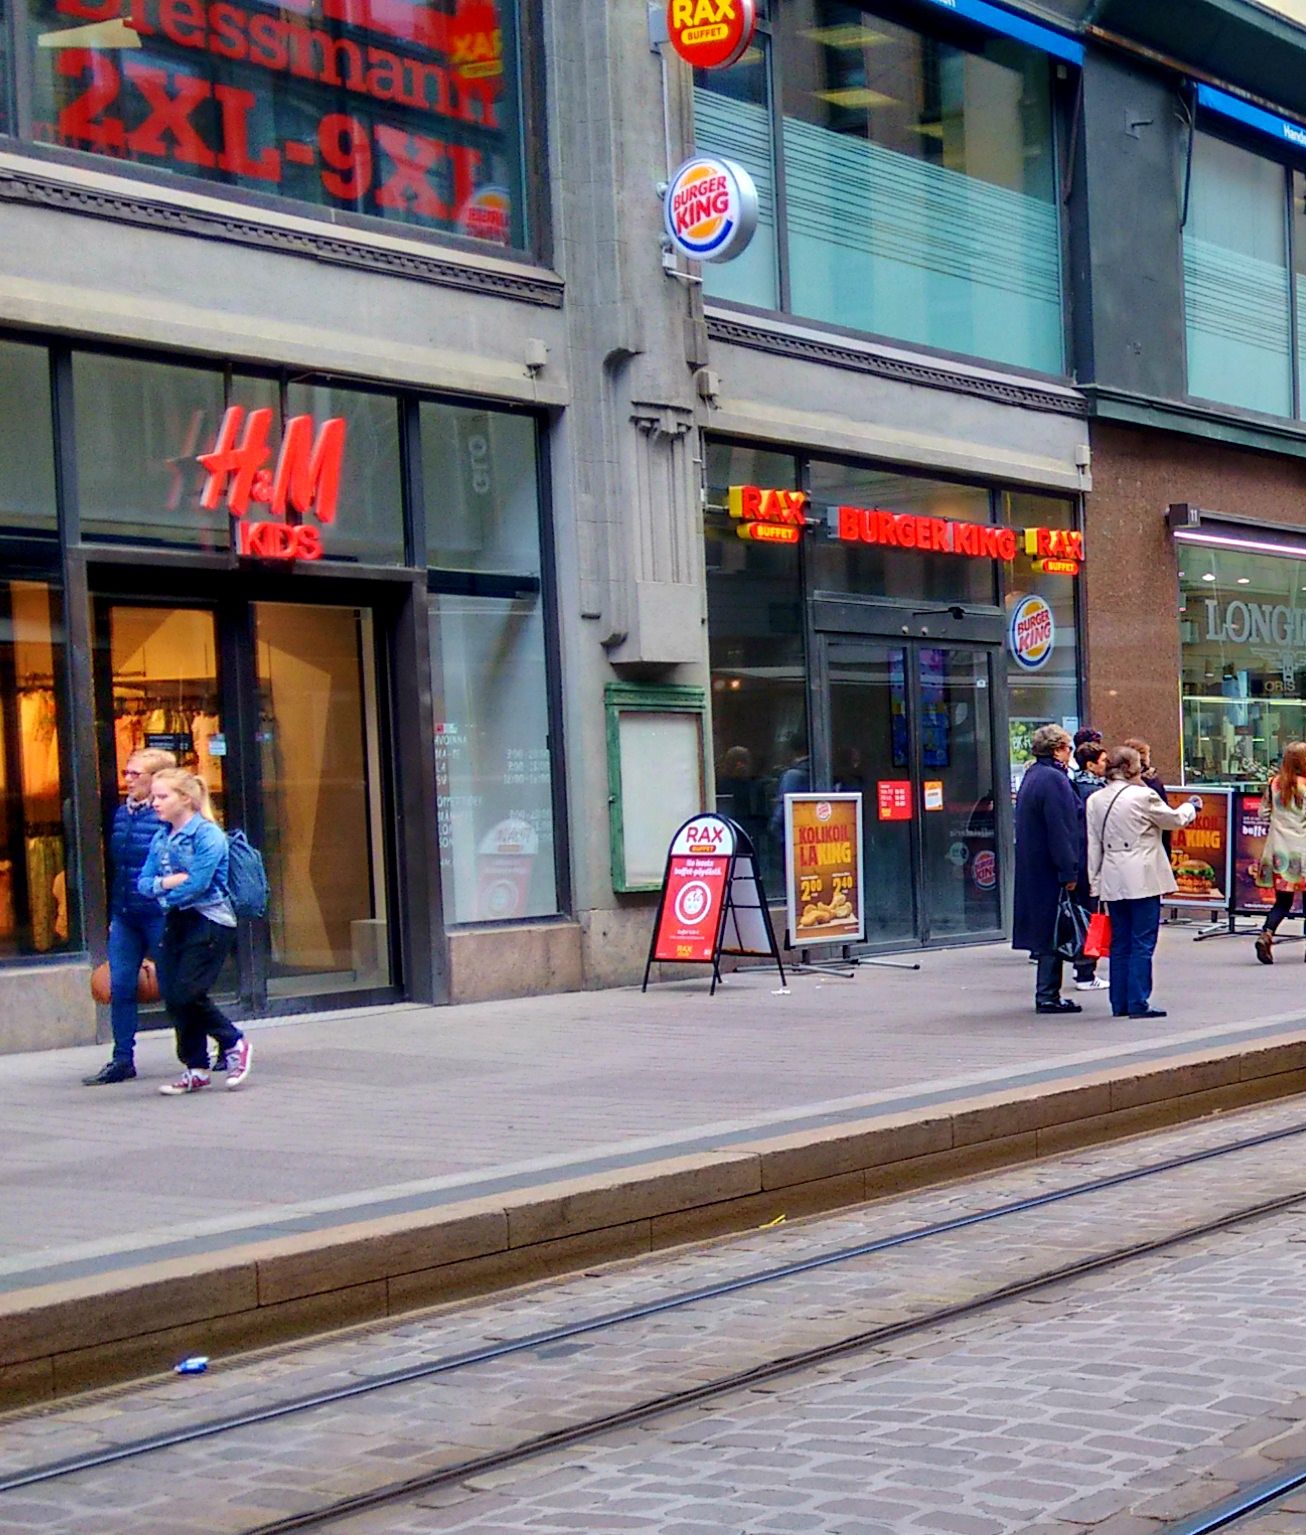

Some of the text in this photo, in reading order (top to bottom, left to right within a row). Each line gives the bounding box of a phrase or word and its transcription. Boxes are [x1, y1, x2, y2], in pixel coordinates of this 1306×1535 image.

[672, 0, 736, 29] RAX
[686, 27, 723, 41] BUFFET
[673, 176, 727, 211] BURGER
[675, 191, 730, 237] KING
[196, 405, 347, 524] H&M
[740, 484, 807, 525] RAX
[236, 520, 323, 561] KIDS
[757, 526, 793, 539] BUFFET
[838, 506, 1017, 560] BURGER KING
[1037, 528, 1084, 561] RAX
[1017, 609, 1050, 636] BURGER
[1018, 622, 1051, 655] KING
[1264, 680, 1296, 692] ORIS
[686, 826, 725, 843] RAX
